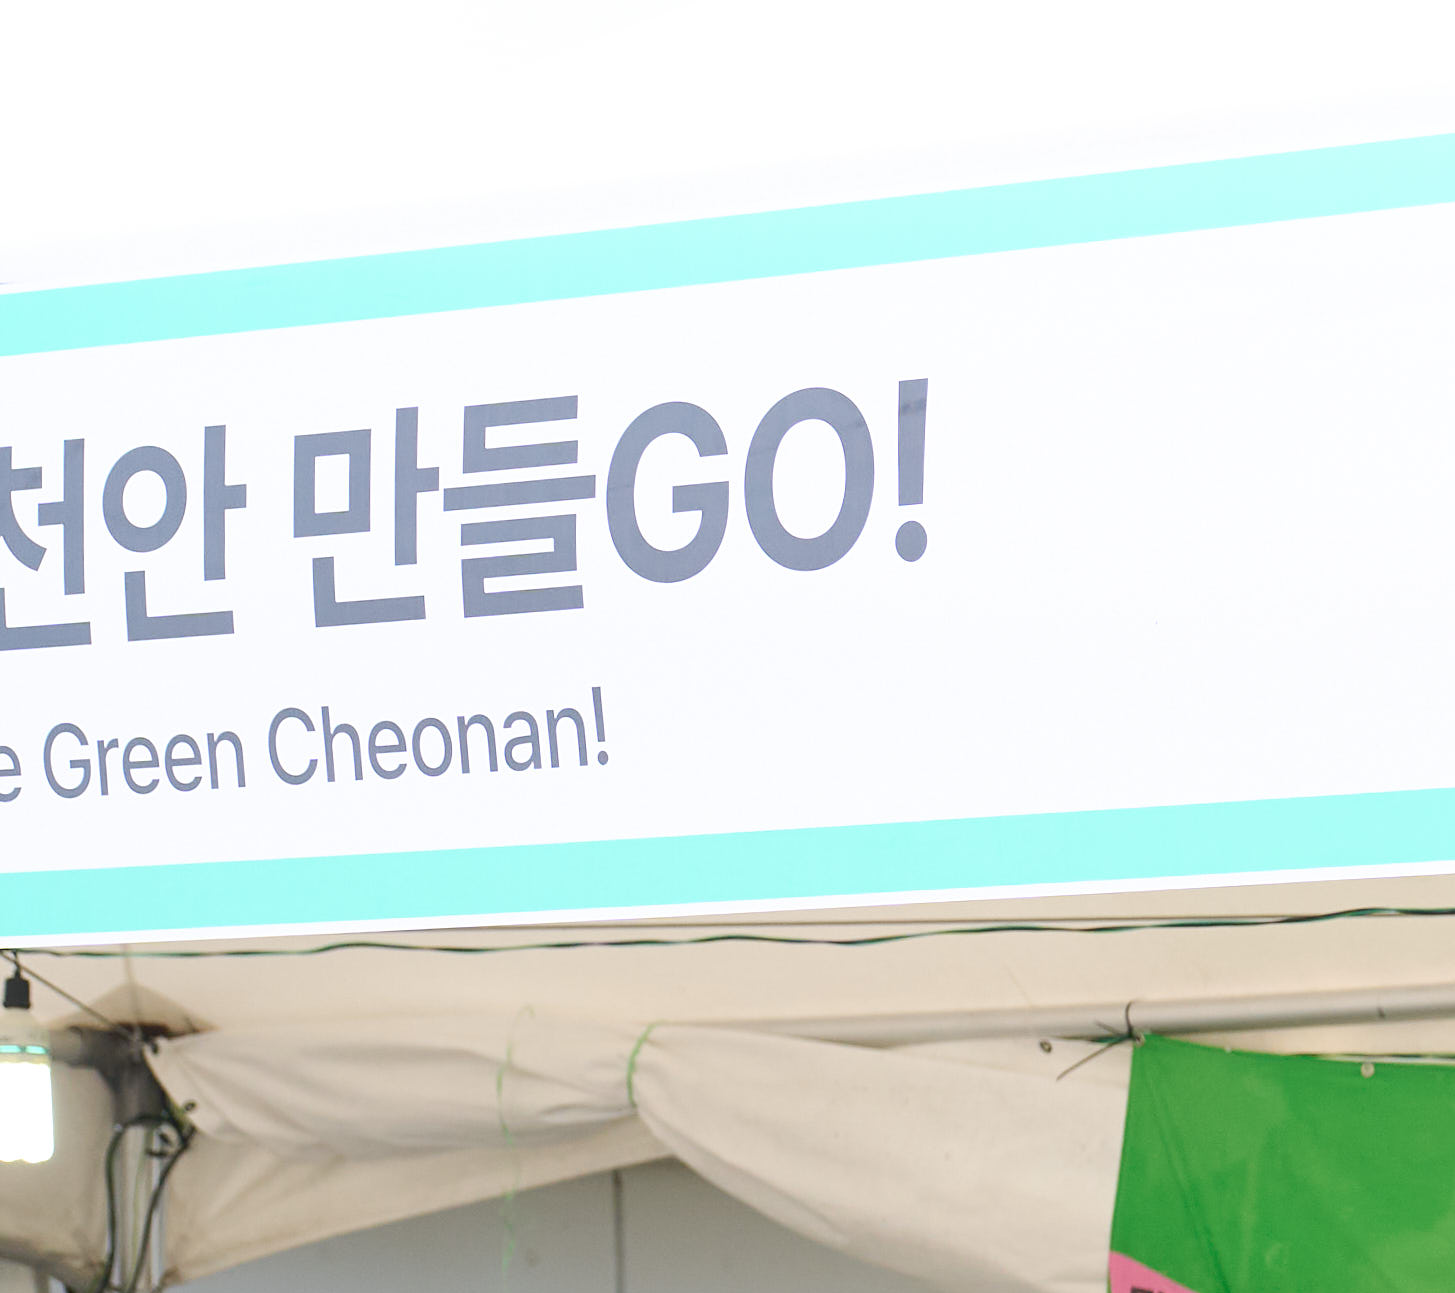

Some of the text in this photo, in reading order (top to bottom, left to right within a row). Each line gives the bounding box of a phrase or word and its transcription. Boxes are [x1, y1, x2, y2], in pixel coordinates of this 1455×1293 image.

[293, 378, 929, 629] 만들GO!
[42, 722, 247, 801] Green
[267, 686, 611, 785] Cheonan!
